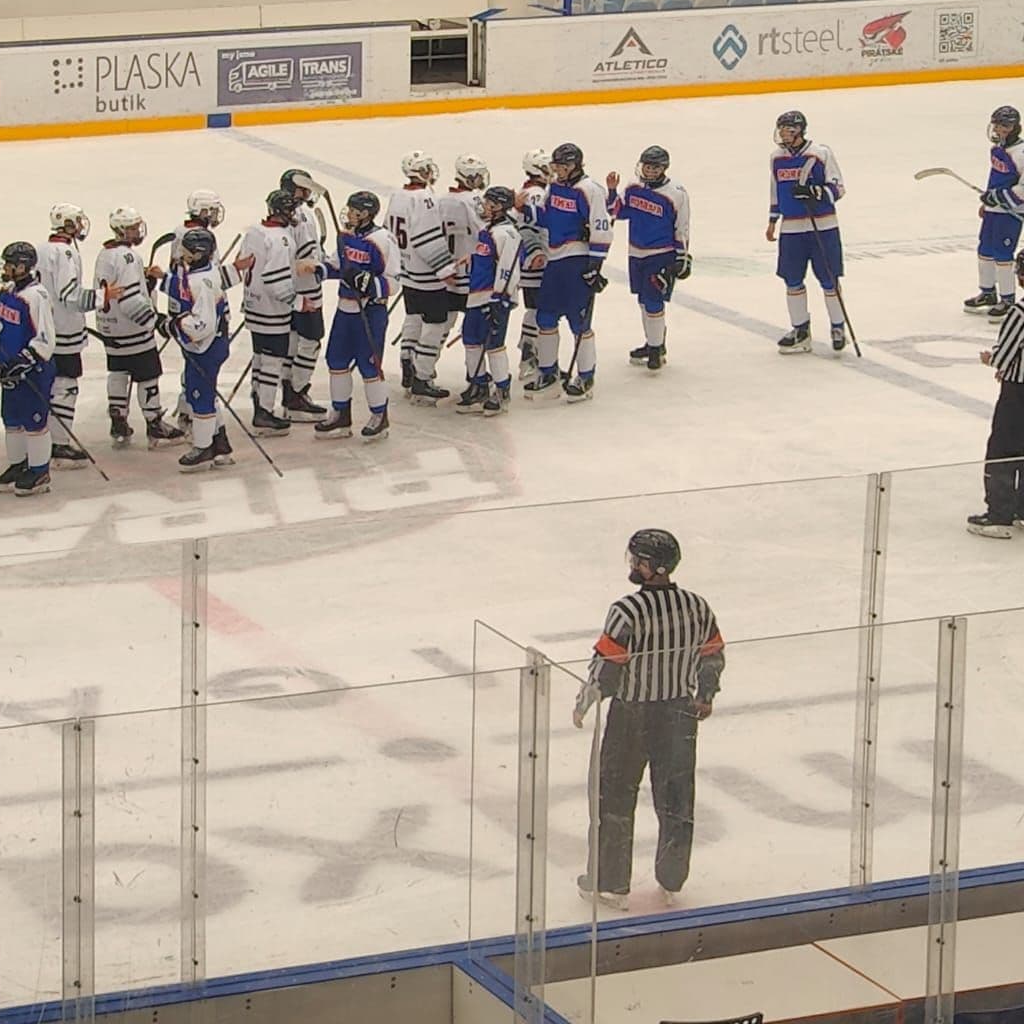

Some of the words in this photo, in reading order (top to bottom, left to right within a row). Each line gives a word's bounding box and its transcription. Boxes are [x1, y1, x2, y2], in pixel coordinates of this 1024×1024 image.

[758, 19, 844, 55] rtsteel
[96, 51, 201, 93] PLASKA
[248, 63, 288, 78] AGILE
[303, 59, 347, 75] TRANS
[593, 58, 668, 72] ATLETICO
[95, 93, 146, 113] butik
[595, 218, 609, 231] 20
